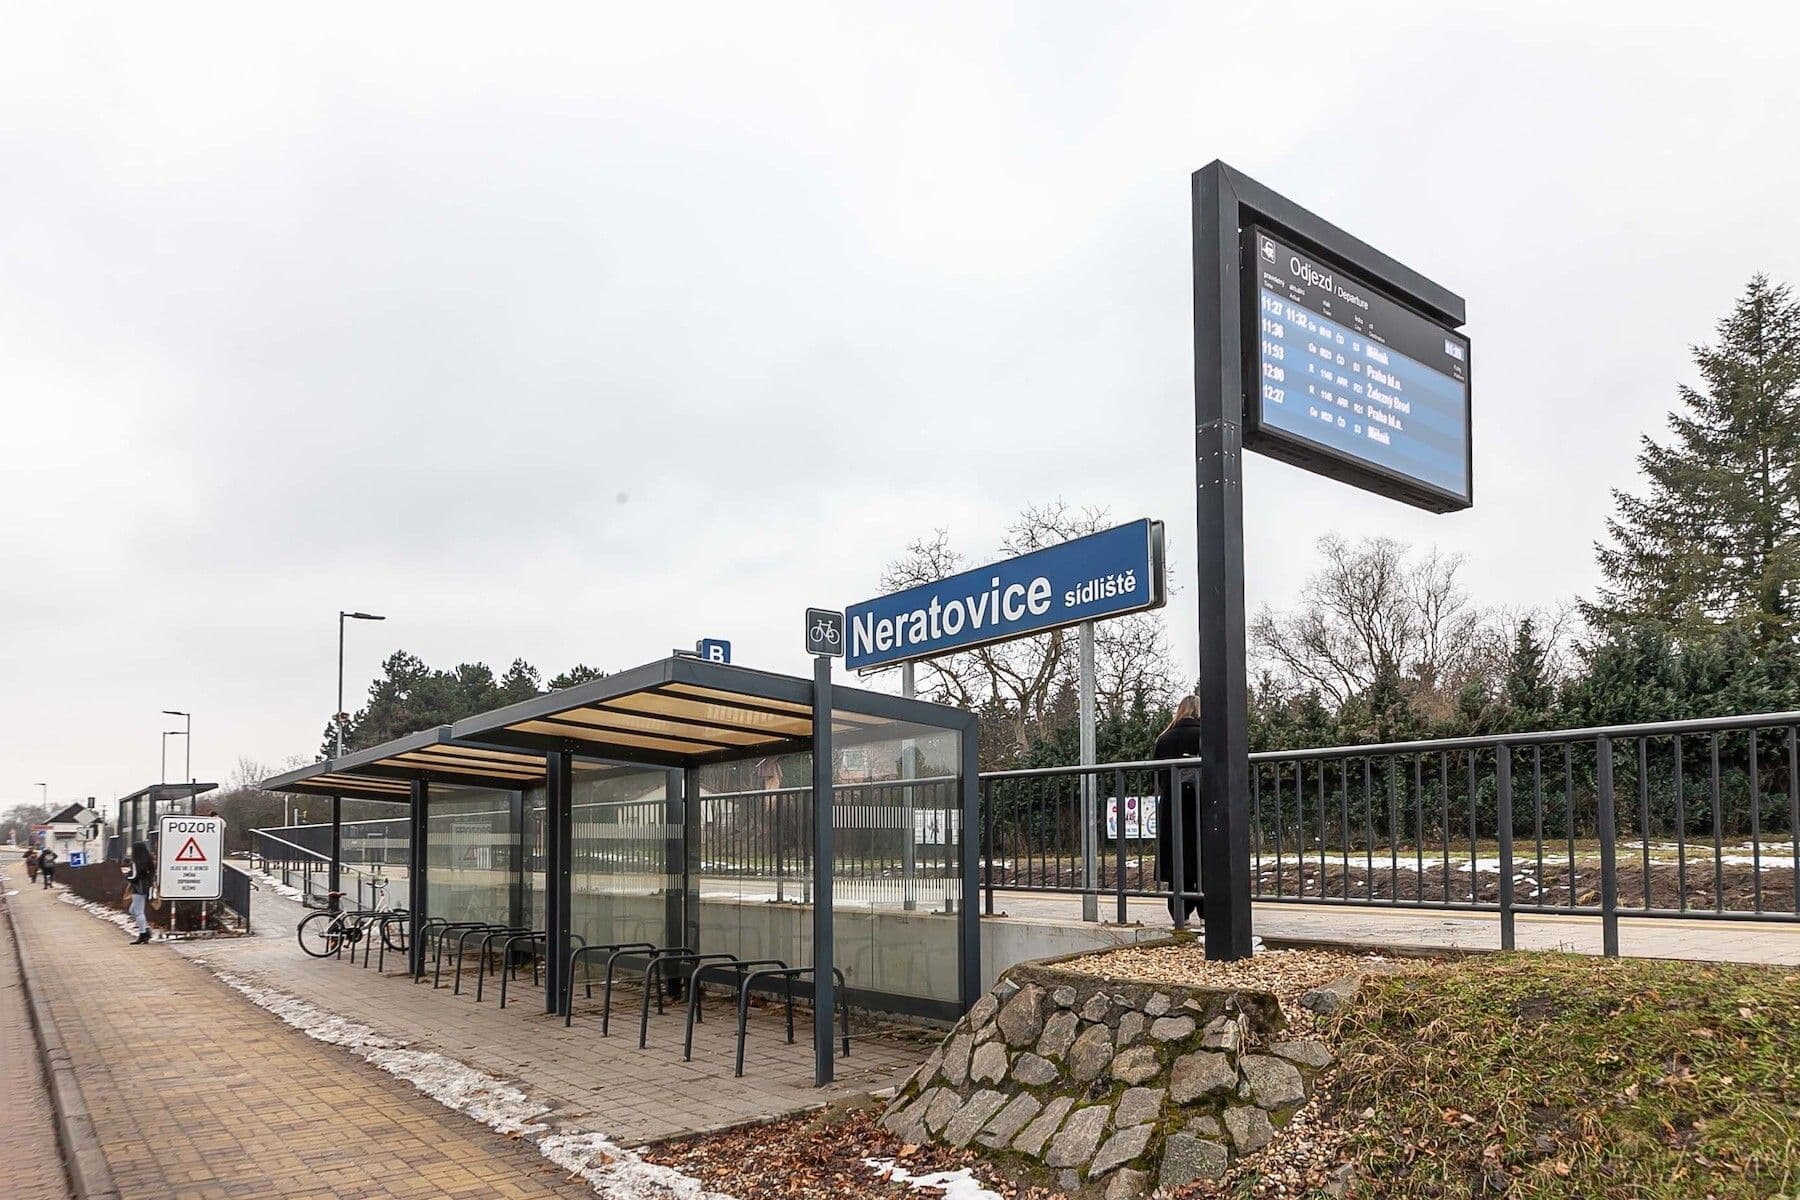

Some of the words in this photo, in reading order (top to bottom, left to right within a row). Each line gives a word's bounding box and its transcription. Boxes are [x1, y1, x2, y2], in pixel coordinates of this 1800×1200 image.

[1290, 256, 1332, 292] Odjezd
[1338, 286, 1369, 310] Departure
[1262, 296, 1283, 316] 11:27
[1262, 340, 1284, 360] 11:53
[1366, 382, 1394, 409] Železný
[1394, 396, 1411, 414] Brod
[1366, 364, 1387, 384] Praha
[1263, 384, 1285, 404] 12:27
[1367, 404, 1388, 424] Praha
[852, 576, 1052, 657] Neratovice
[1064, 569, 1137, 608] sídliště
[710, 645, 724, 663] B
[168, 822, 216, 833] POZOR
